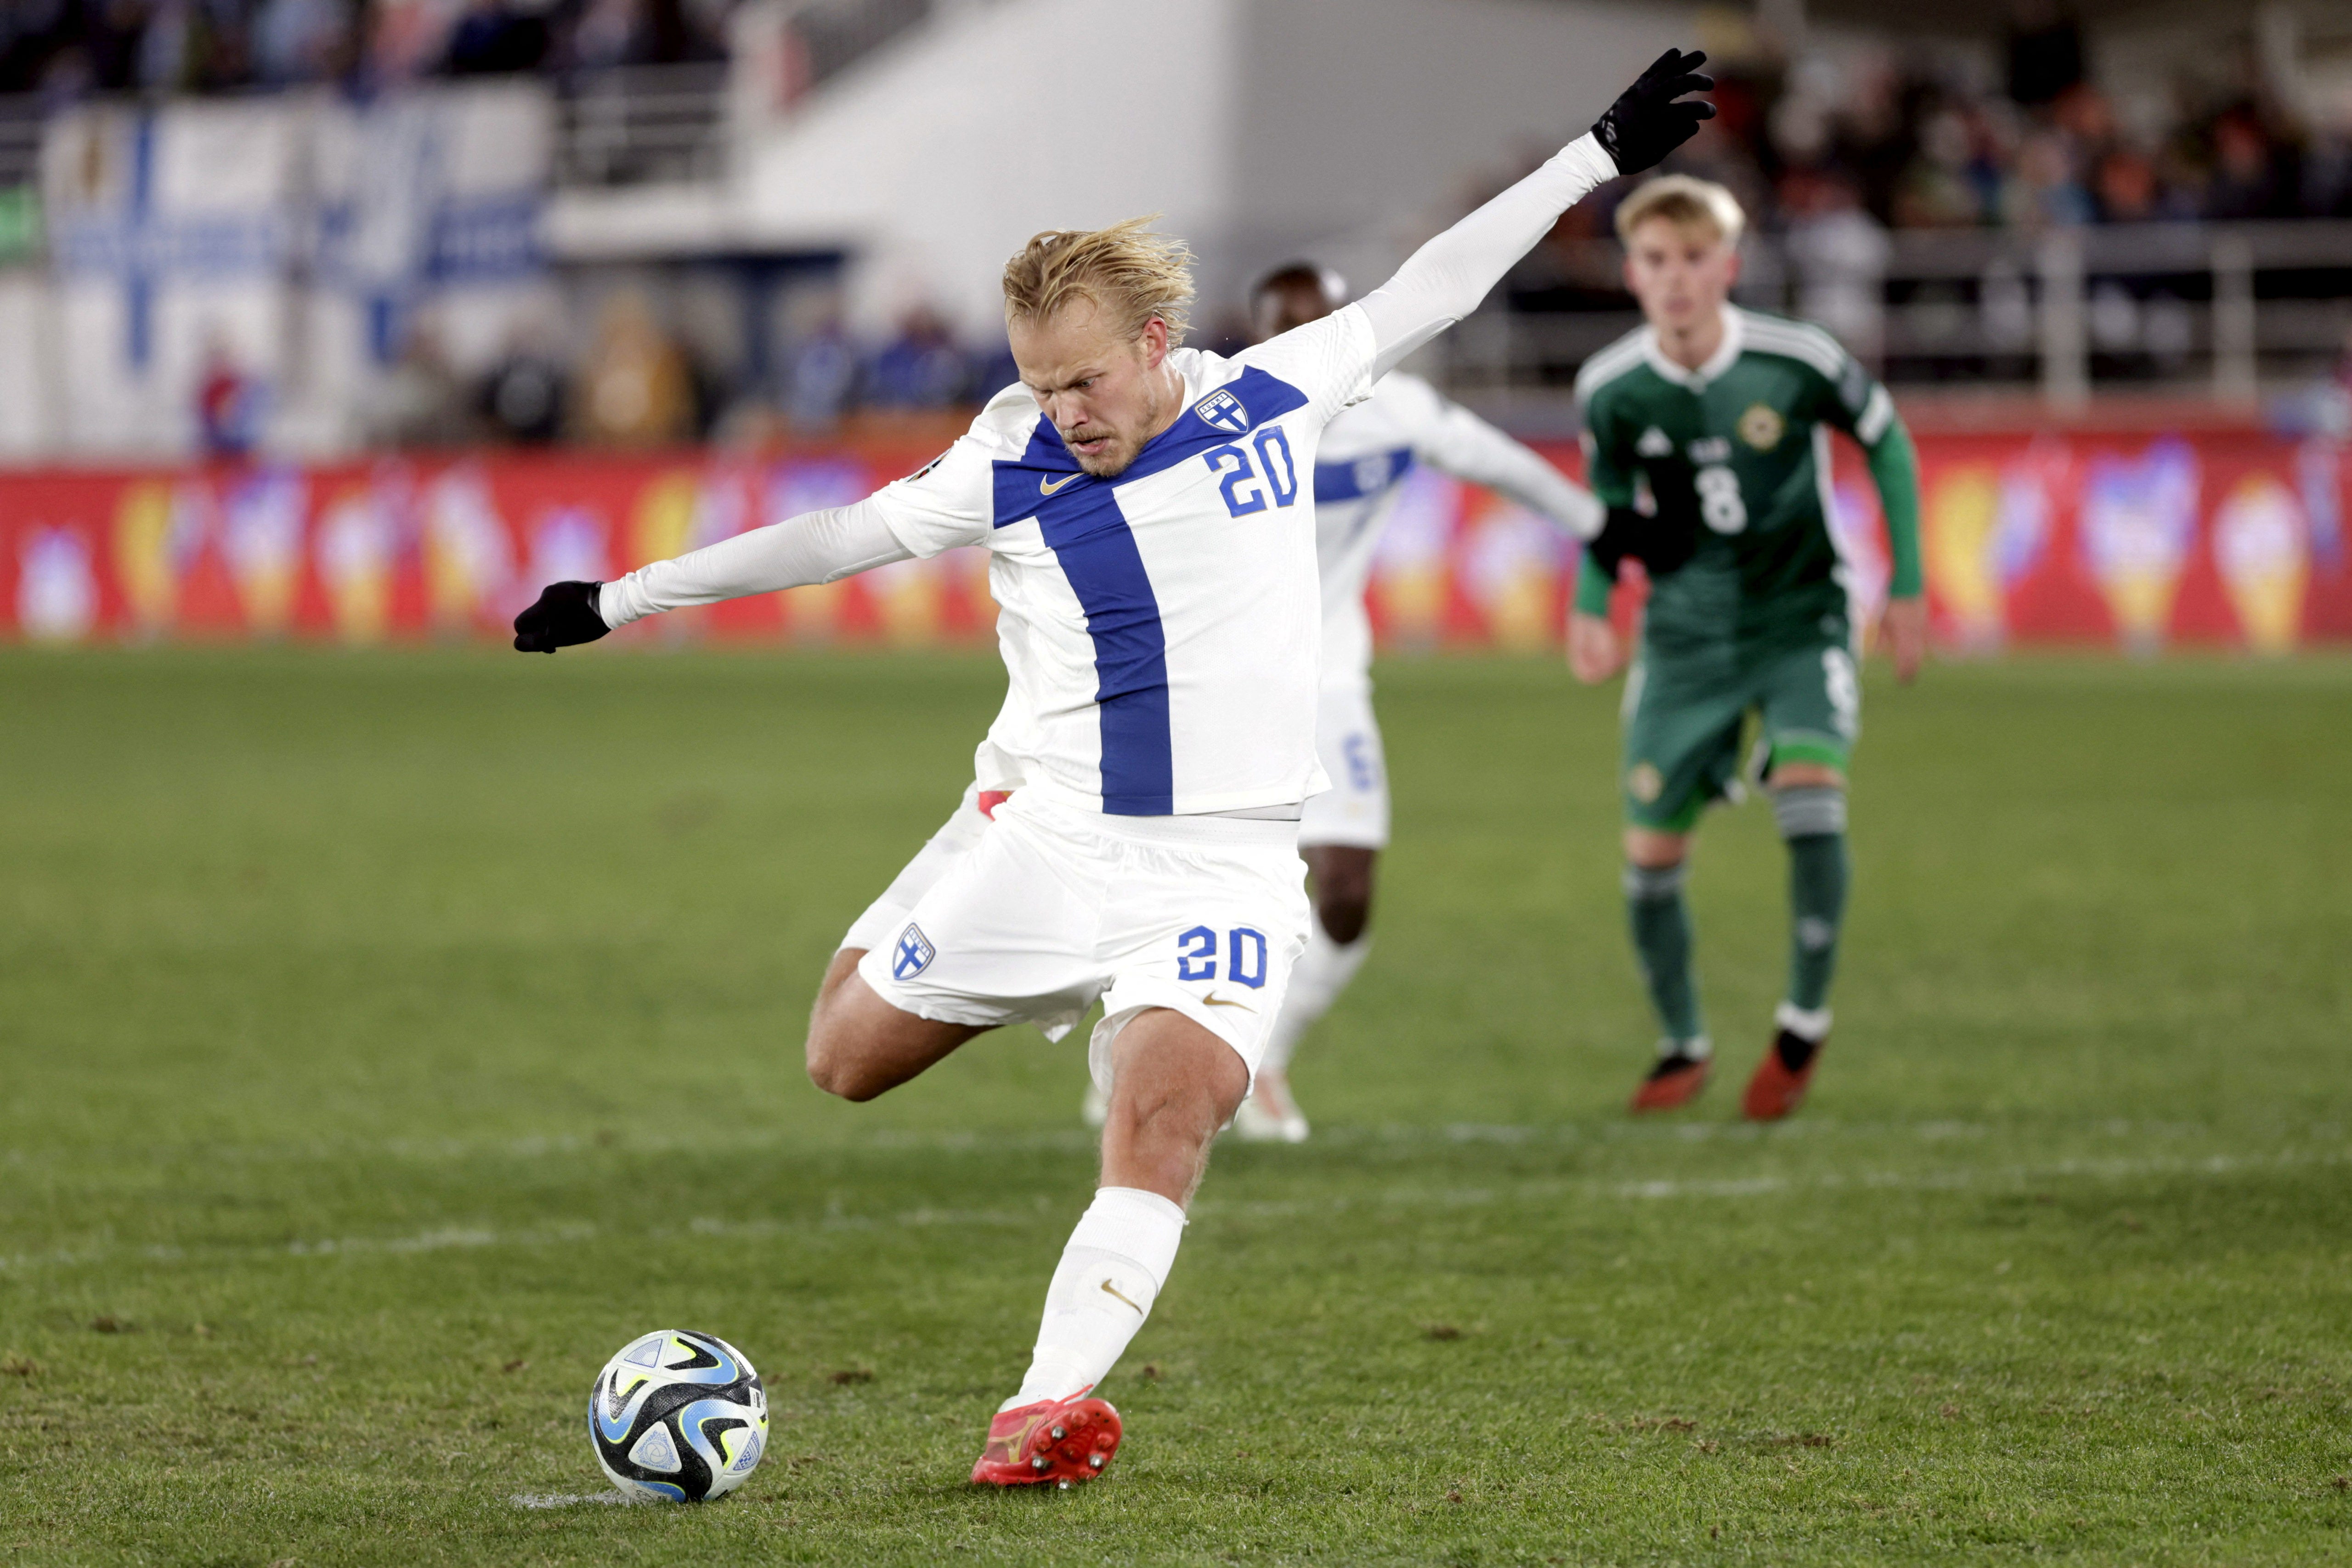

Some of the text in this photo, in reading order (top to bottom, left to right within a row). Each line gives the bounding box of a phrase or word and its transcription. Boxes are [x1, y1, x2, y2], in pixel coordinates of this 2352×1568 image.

[1202, 395, 1225, 412] SUOMI
[1202, 425, 1298, 519] 20
[1695, 465, 1748, 535] 8
[1177, 925, 1267, 990] 20
